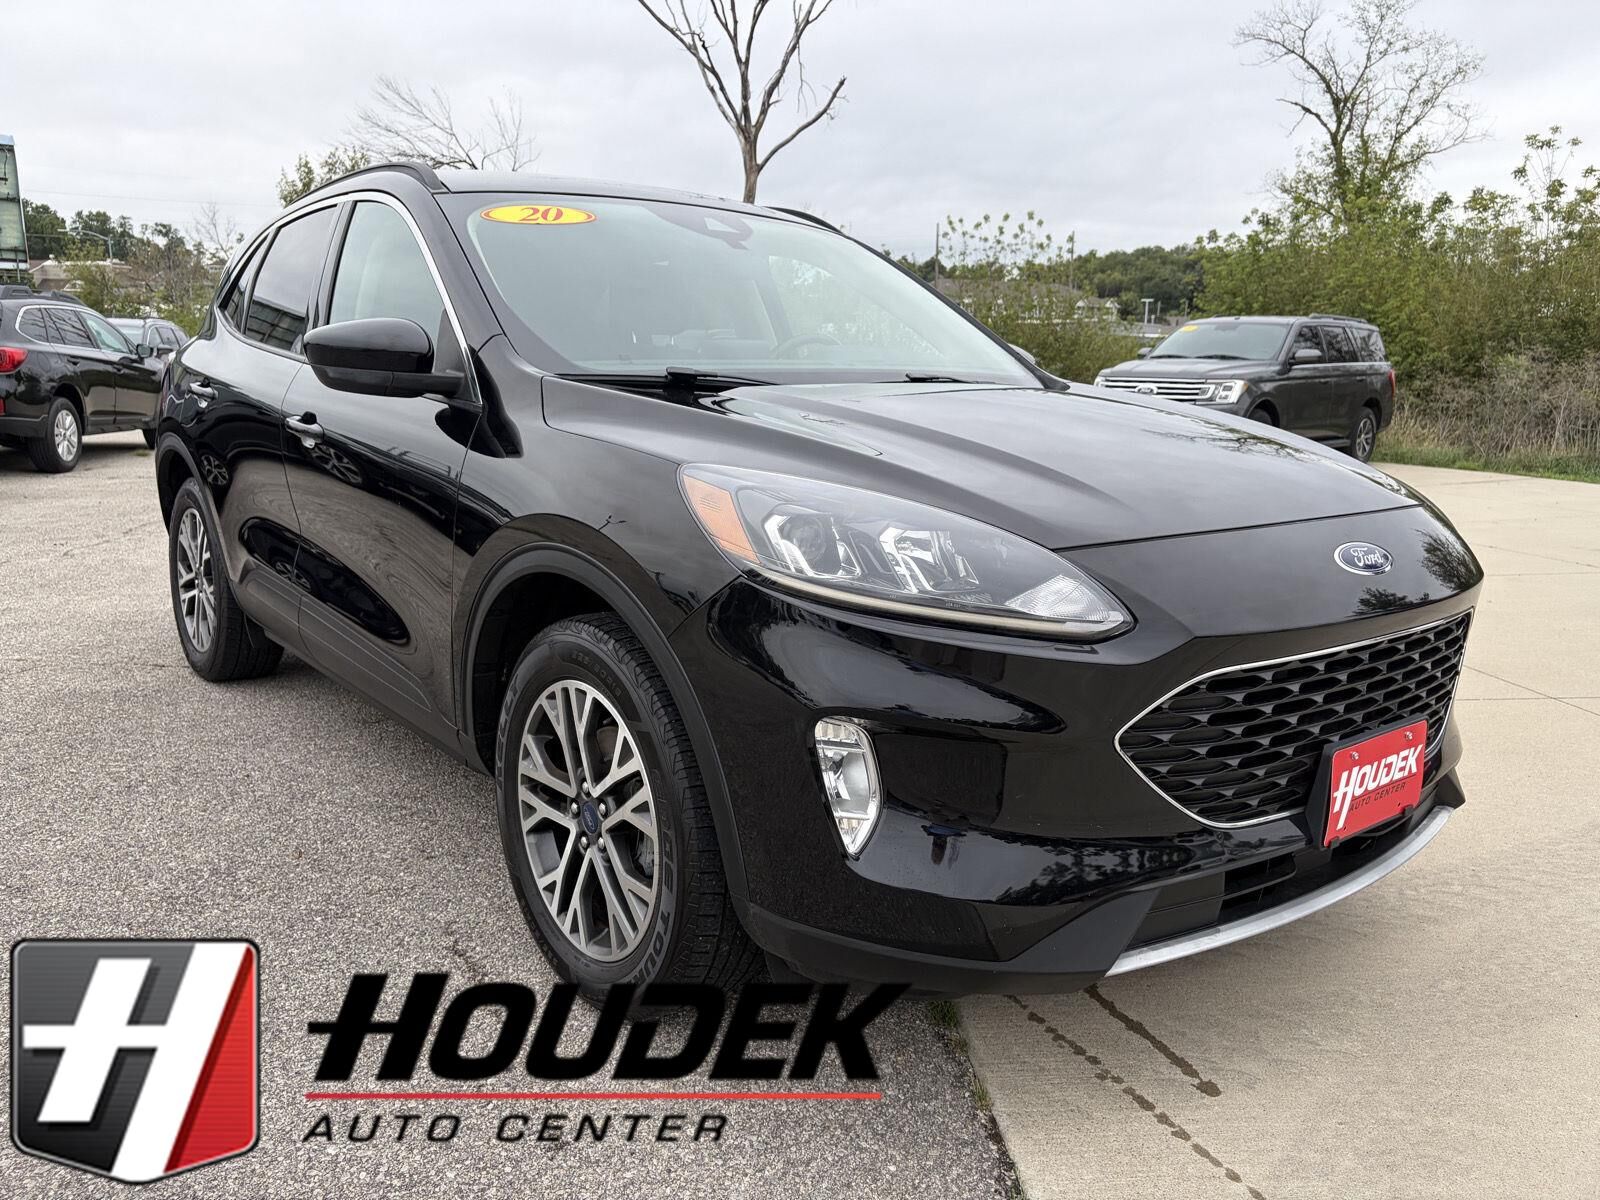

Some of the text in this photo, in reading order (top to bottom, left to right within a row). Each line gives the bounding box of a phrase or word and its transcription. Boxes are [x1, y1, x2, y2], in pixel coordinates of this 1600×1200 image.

[518, 207, 563, 222] 20
[1350, 547, 1384, 567] Ford
[1333, 744, 1423, 831] HOUDEK
[1350, 782, 1406, 812] AUTO CENTER
